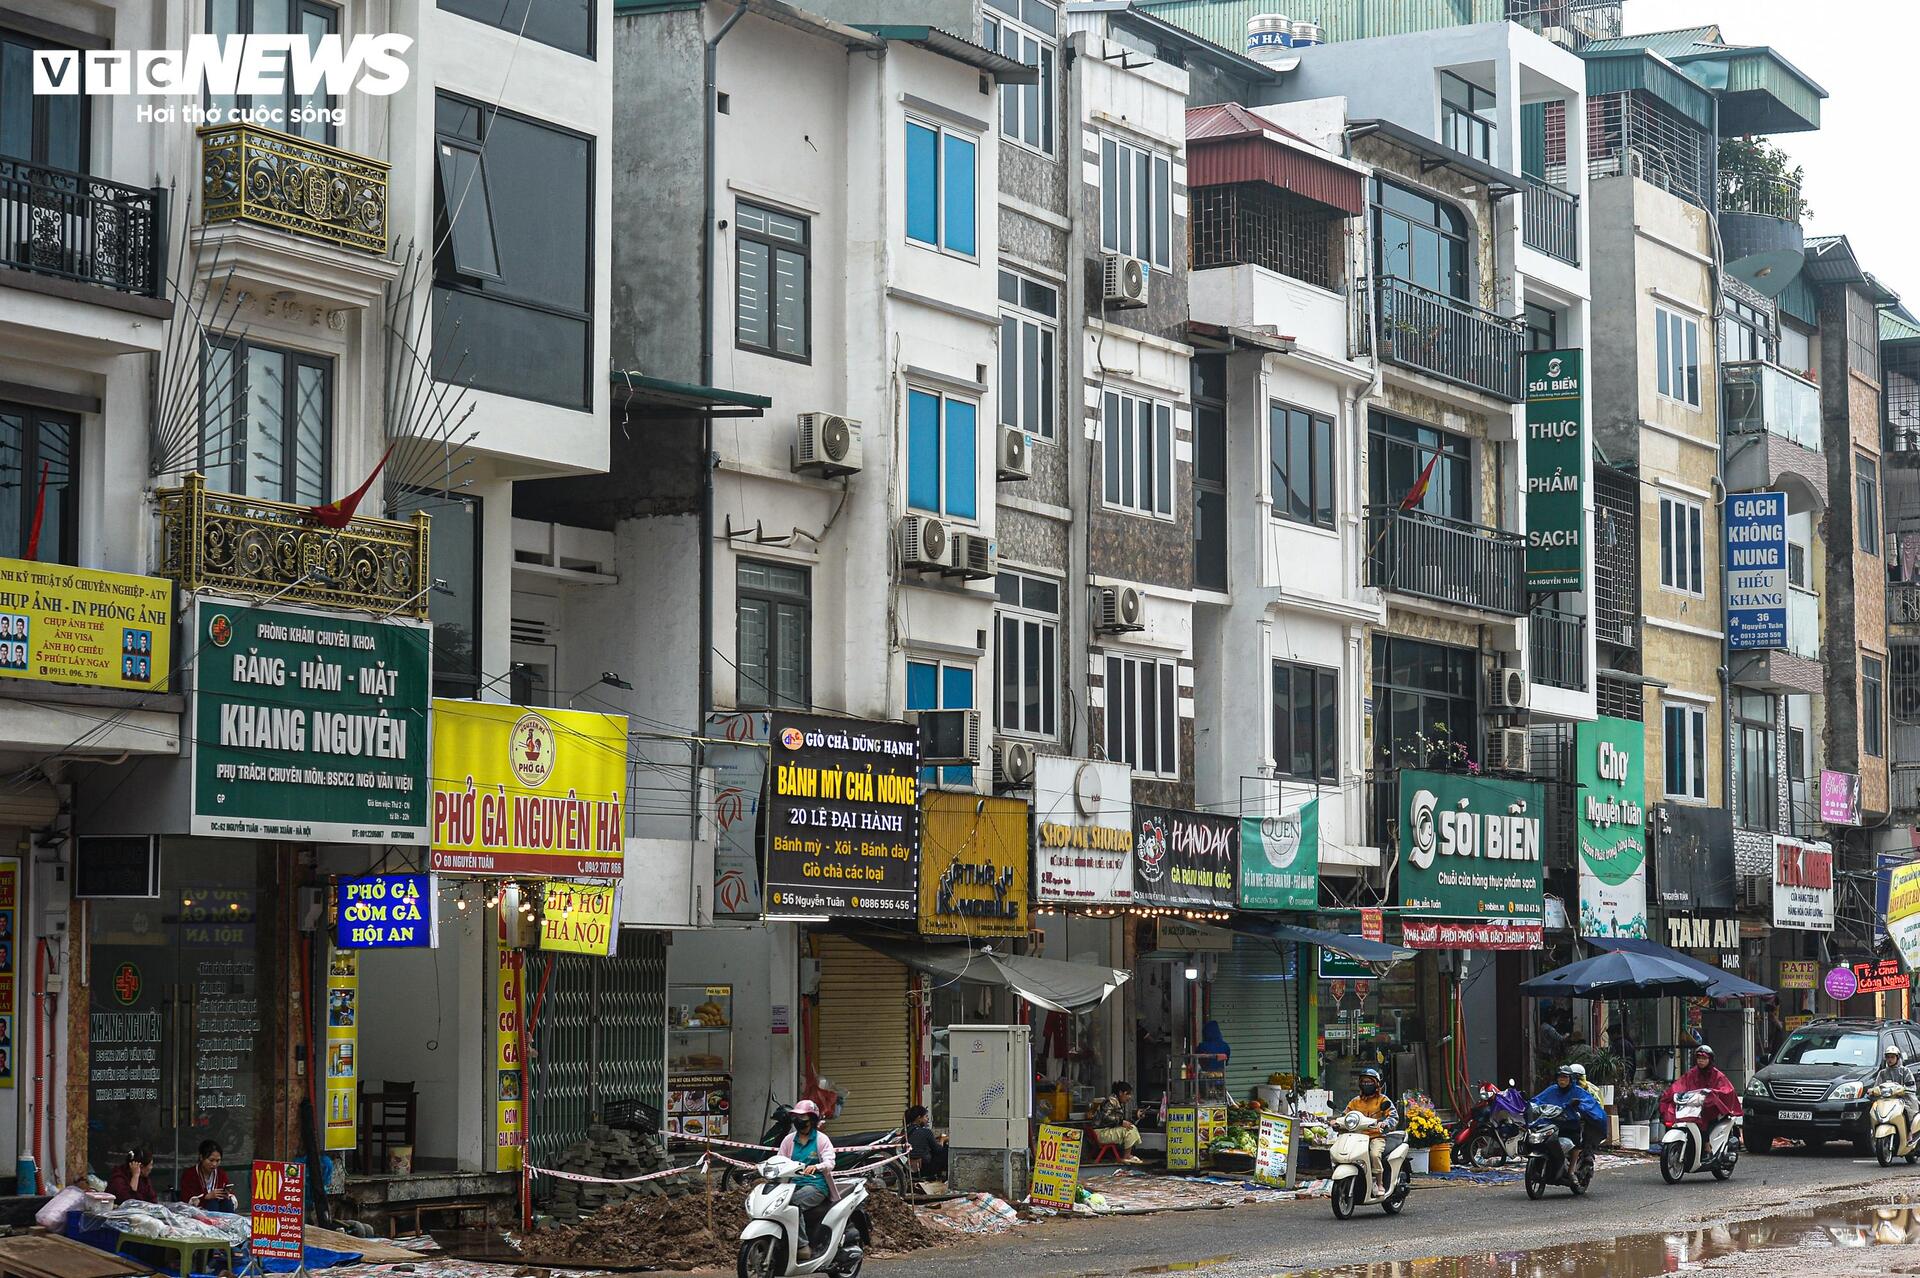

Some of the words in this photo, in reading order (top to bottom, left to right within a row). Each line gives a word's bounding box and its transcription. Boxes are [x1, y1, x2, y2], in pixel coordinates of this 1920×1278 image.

[1529, 378, 1548, 392] SÓI
[1552, 377, 1577, 390] BIỂN
[1529, 420, 1577, 442] THỰC
[1528, 467, 1578, 494] PHẨM
[1734, 500, 1776, 520] GẠCH
[1529, 530, 1578, 551] SẠCH
[1729, 522, 1783, 543] KHÔNG
[1733, 548, 1778, 566] NUNG
[0, 570, 15, 582] NH
[16, 570, 29, 583] KỸ
[31, 573, 60, 588] THUẬT
[62, 575, 74, 589] SỐ
[76, 579, 110, 593] CHUYÊN
[113, 584, 145, 599] NGHIỆP
[150, 591, 167, 600] ATV
[1537, 576, 1560, 585] NGUYỄN
[1561, 577, 1578, 585] TUÂN
[1738, 571, 1773, 588] HIẾU
[0, 592, 29, 611] HỤP
[32, 591, 61, 612] ẢNH
[72, 600, 86, 615] IN
[90, 601, 135, 621] PHÓNG
[138, 604, 167, 625] ẢNH
[1730, 593, 1782, 606] KHANG
[44, 617, 66, 630] CHỤP
[68, 618, 86, 629] ẢNH
[1757, 613, 1769, 622] 36
[55, 630, 72, 640] ẢNH
[75, 631, 93, 642] VISA
[257, 622, 287, 641] PHÒNG
[289, 626, 314, 644] KHÁM
[317, 630, 350, 647] CHUYÊN
[352, 635, 375, 650] KHOA
[36, 651, 42, 661] 5
[44, 655, 66, 664] PHÚT
[69, 654, 88, 666] LẤY
[87, 659, 110, 668] NGAY
[233, 648, 285, 686] RĂNG
[300, 655, 341, 691] HÀM
[359, 660, 398, 704] MẶT
[220, 703, 305, 752] KHANG
[312, 709, 406, 759] NGUYÊN
[806, 729, 824, 747] GIÒ
[827, 730, 849, 750] CHẢ
[852, 735, 881, 752] DŨNG
[884, 741, 913, 757] HẠNH
[519, 762, 534, 773] PHỞ
[535, 762, 545, 774] GÀ
[1598, 741, 1629, 786] Chợ
[216, 763, 236, 782] PHỤ
[237, 763, 266, 780] TRÁCH
[268, 766, 302, 783] CHUYÊN
[304, 768, 326, 784] MÔN:
[327, 770, 354, 786] BSCK2
[356, 771, 375, 788] NGÔ
[377, 770, 393, 789] VĂN
[396, 774, 413, 794] VIỆN
[778, 760, 817, 797] BÁNH
[821, 764, 842, 799] MỲ
[846, 764, 873, 802] CHẢ
[878, 768, 915, 805] NÓNG
[434, 776, 476, 845] PHỞ
[481, 784, 508, 846] GÀ
[514, 789, 591, 850] NGUYÊN
[596, 793, 621, 851] HÀ
[790, 808, 807, 825] 20
[811, 807, 827, 826] LÊ
[831, 811, 856, 833] ĐẠI
[861, 810, 902, 832] HÀNH
[1586, 796, 1620, 828] Nguyễn
[1622, 799, 1642, 826] Tuân
[1172, 820, 1233, 861] HANDAK
[1439, 798, 1480, 858] SÓI
[1484, 799, 1540, 861] BIỂN
[774, 835, 802, 852] Bánh
[804, 838, 822, 856] mỳ
[834, 840, 851, 855] Xôi
[861, 842, 888, 858] Bánh
[891, 845, 910, 862] dày
[443, 855, 451, 867] 60
[452, 854, 477, 868] NGUYỄN
[478, 856, 493, 869] TUÂN
[1776, 844, 1803, 886] HK
[803, 862, 820, 877] Giò
[823, 863, 842, 879] chả
[845, 865, 863, 879] các
[866, 865, 884, 886] loại
[1171, 865, 1180, 884] GÀ
[1182, 865, 1197, 885] RÁN
[1198, 868, 1213, 887] HÀN
[1215, 866, 1231, 889] QUỐC
[1438, 869, 1458, 885] Chuỗi
[1458, 872, 1471, 886] cửa
[1472, 875, 1488, 890] hàng
[1489, 875, 1503, 890] thực
[1504, 873, 1522, 889] phẩm
[1522, 879, 1536, 892] sạch
[347, 878, 386, 900] PHỞ
[391, 879, 419, 899] GÀ
[345, 906, 387, 921] CƠM
[392, 903, 421, 921] GÀ
[782, 893, 794, 905] 56
[795, 893, 825, 908] Nguyễn
[826, 895, 845, 907] Tuân
[860, 897, 879, 909] 0886
[880, 898, 894, 909] 956
[895, 899, 909, 910] 456
[352, 924, 383, 945] HỘI
[388, 927, 414, 942] AN
[545, 918, 568, 940] HÀ
[576, 918, 605, 948] NỘI
[1668, 909, 1710, 948] TÂM
[1714, 919, 1740, 948] AN
[1722, 954, 1740, 969] HAIR
[1782, 962, 1815, 973] PATE
[1039, 1135, 1058, 1161] XÔI
[255, 1164, 277, 1200] XÔI
[1034, 1179, 1054, 1196] BÁNH
[253, 1214, 276, 1235] BÁNH
